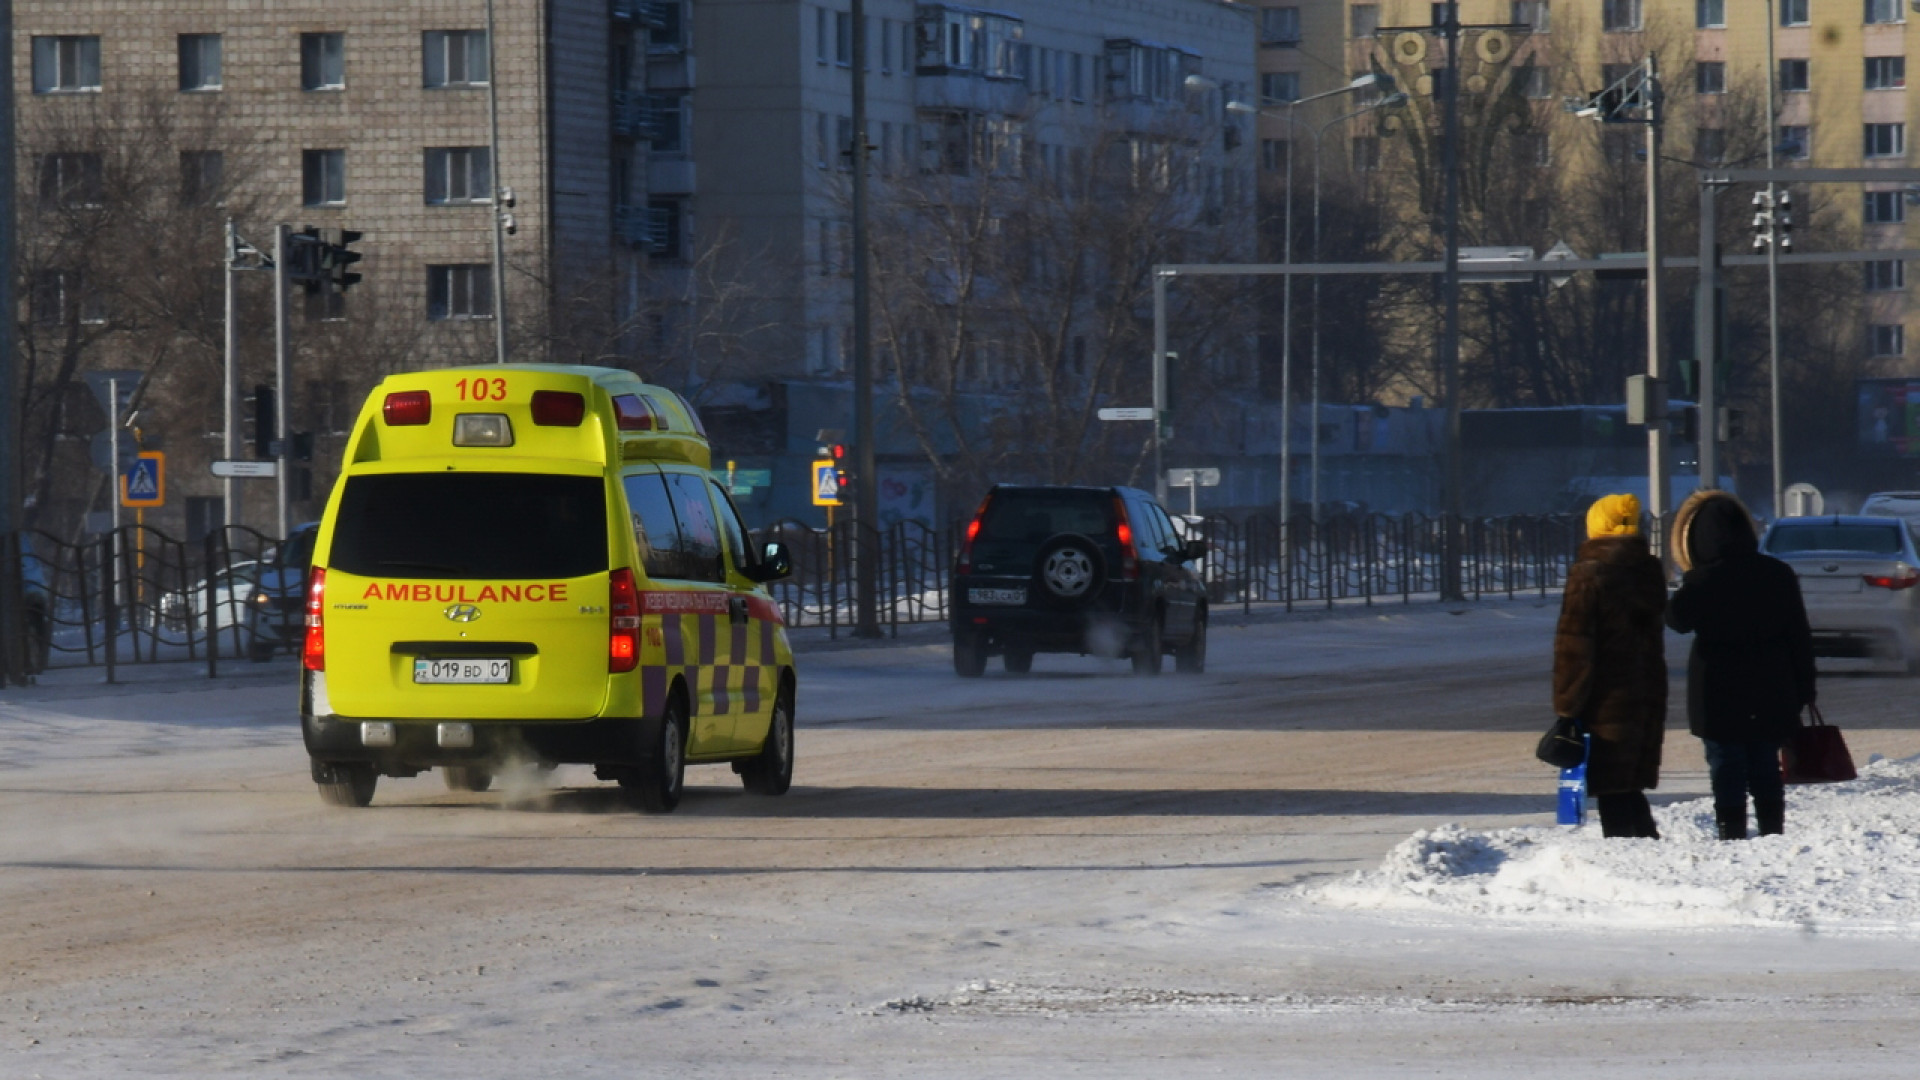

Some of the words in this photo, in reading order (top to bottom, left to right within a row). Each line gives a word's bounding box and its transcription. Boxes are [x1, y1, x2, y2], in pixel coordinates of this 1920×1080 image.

[456, 377, 507, 401] 103
[363, 583, 568, 602] AMBULANCE
[432, 662, 460, 677] 019
[464, 665, 482, 677] BD
[491, 662, 508, 677] 01
